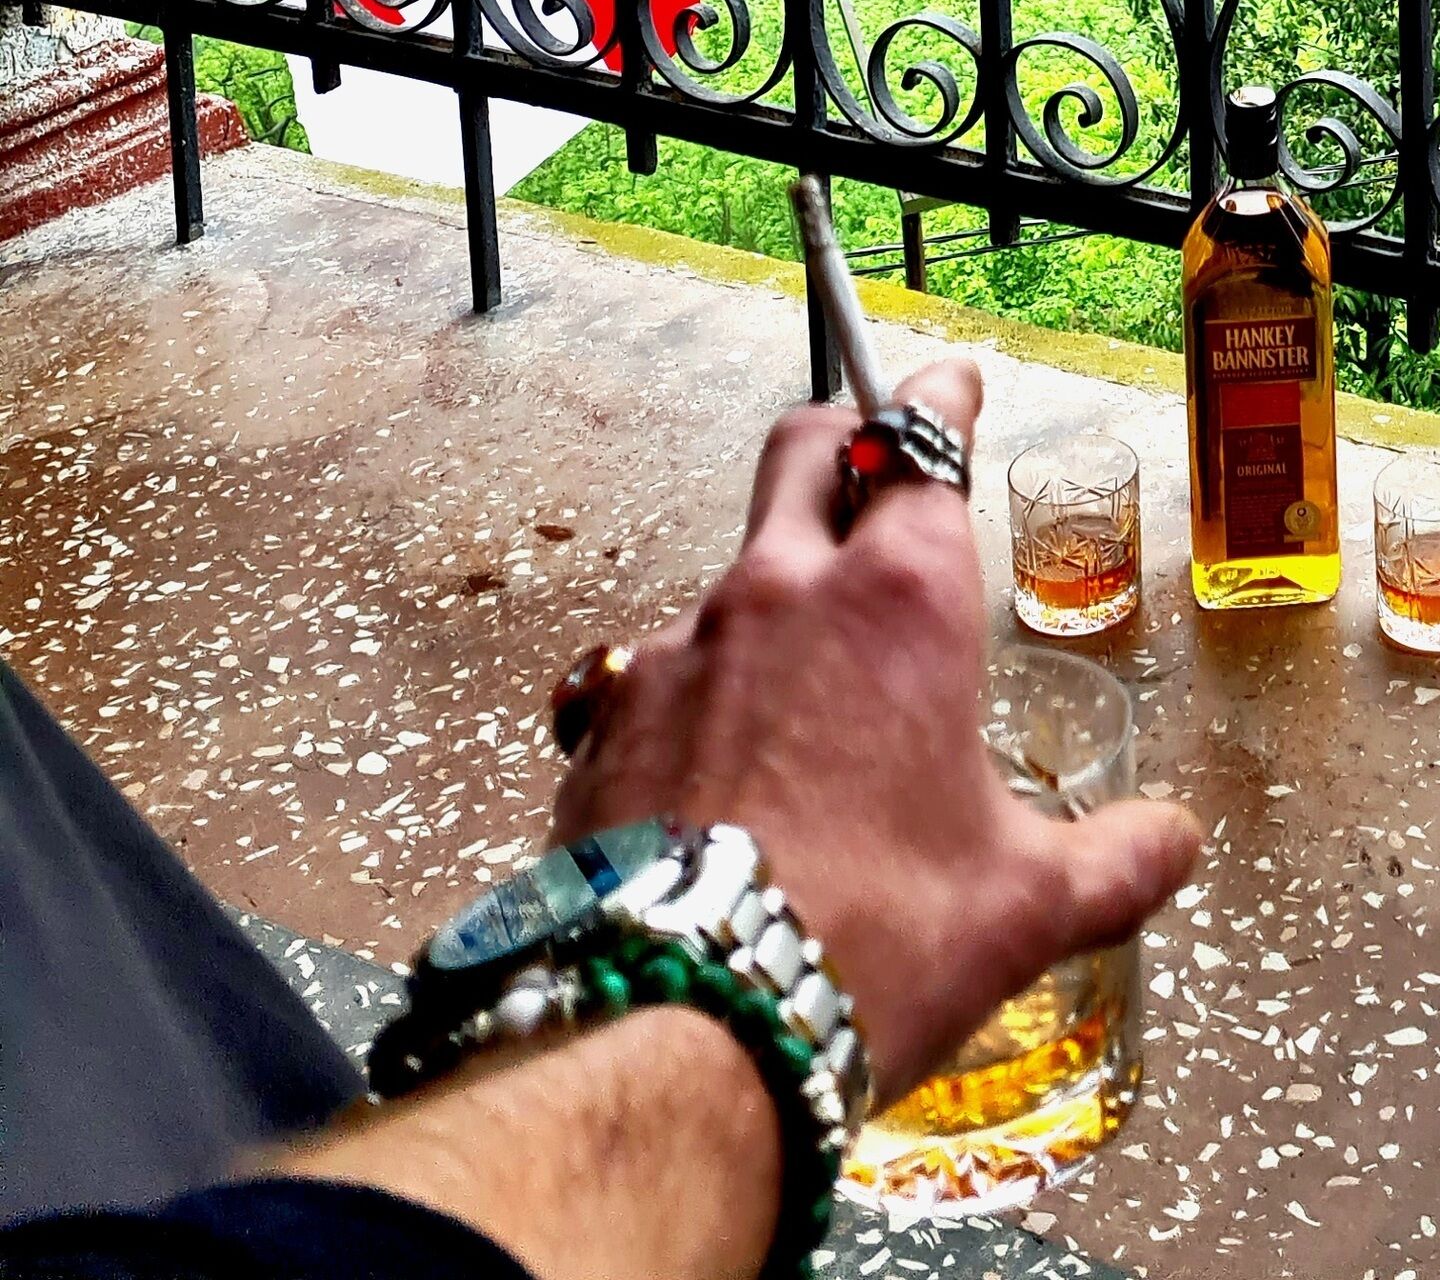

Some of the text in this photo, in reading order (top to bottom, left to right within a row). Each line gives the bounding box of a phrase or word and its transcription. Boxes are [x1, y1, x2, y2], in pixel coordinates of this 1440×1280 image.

[1226, 325, 1295, 348] HANKEY
[1213, 347, 1310, 371] BANNISTER
[1237, 462, 1288, 478] ORIGINAL
